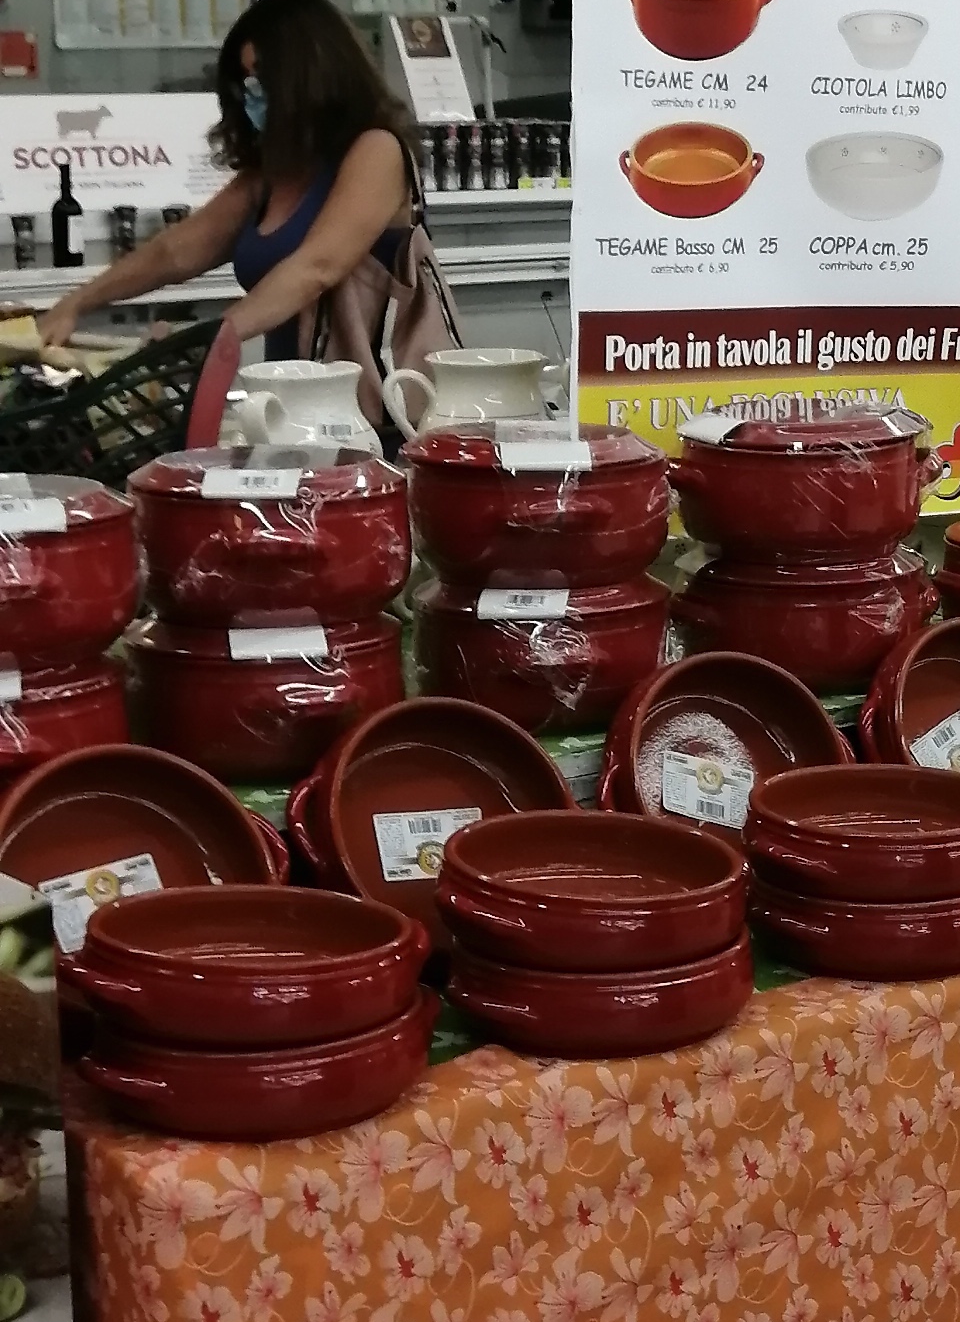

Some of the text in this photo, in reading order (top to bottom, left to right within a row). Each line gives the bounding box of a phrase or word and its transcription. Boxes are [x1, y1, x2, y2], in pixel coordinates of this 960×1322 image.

[620, 69, 768, 93] TEGAME CM 24
[810, 76, 947, 100] CIOTOLA LIMBO
[839, 104, 888, 116] contributo
[13, 145, 172, 169] SCOTTONA
[595, 237, 778, 256] TEGAME Basso CM 25
[809, 236, 929, 256] COPPA cm. 25
[819, 260, 873, 271] contributo
[605, 334, 681, 372] Porta
[686, 332, 711, 369] in
[716, 329, 792, 368] tavola
[796, 328, 813, 364] il
[817, 328, 891, 371] gusto
[896, 327, 937, 362] dei
